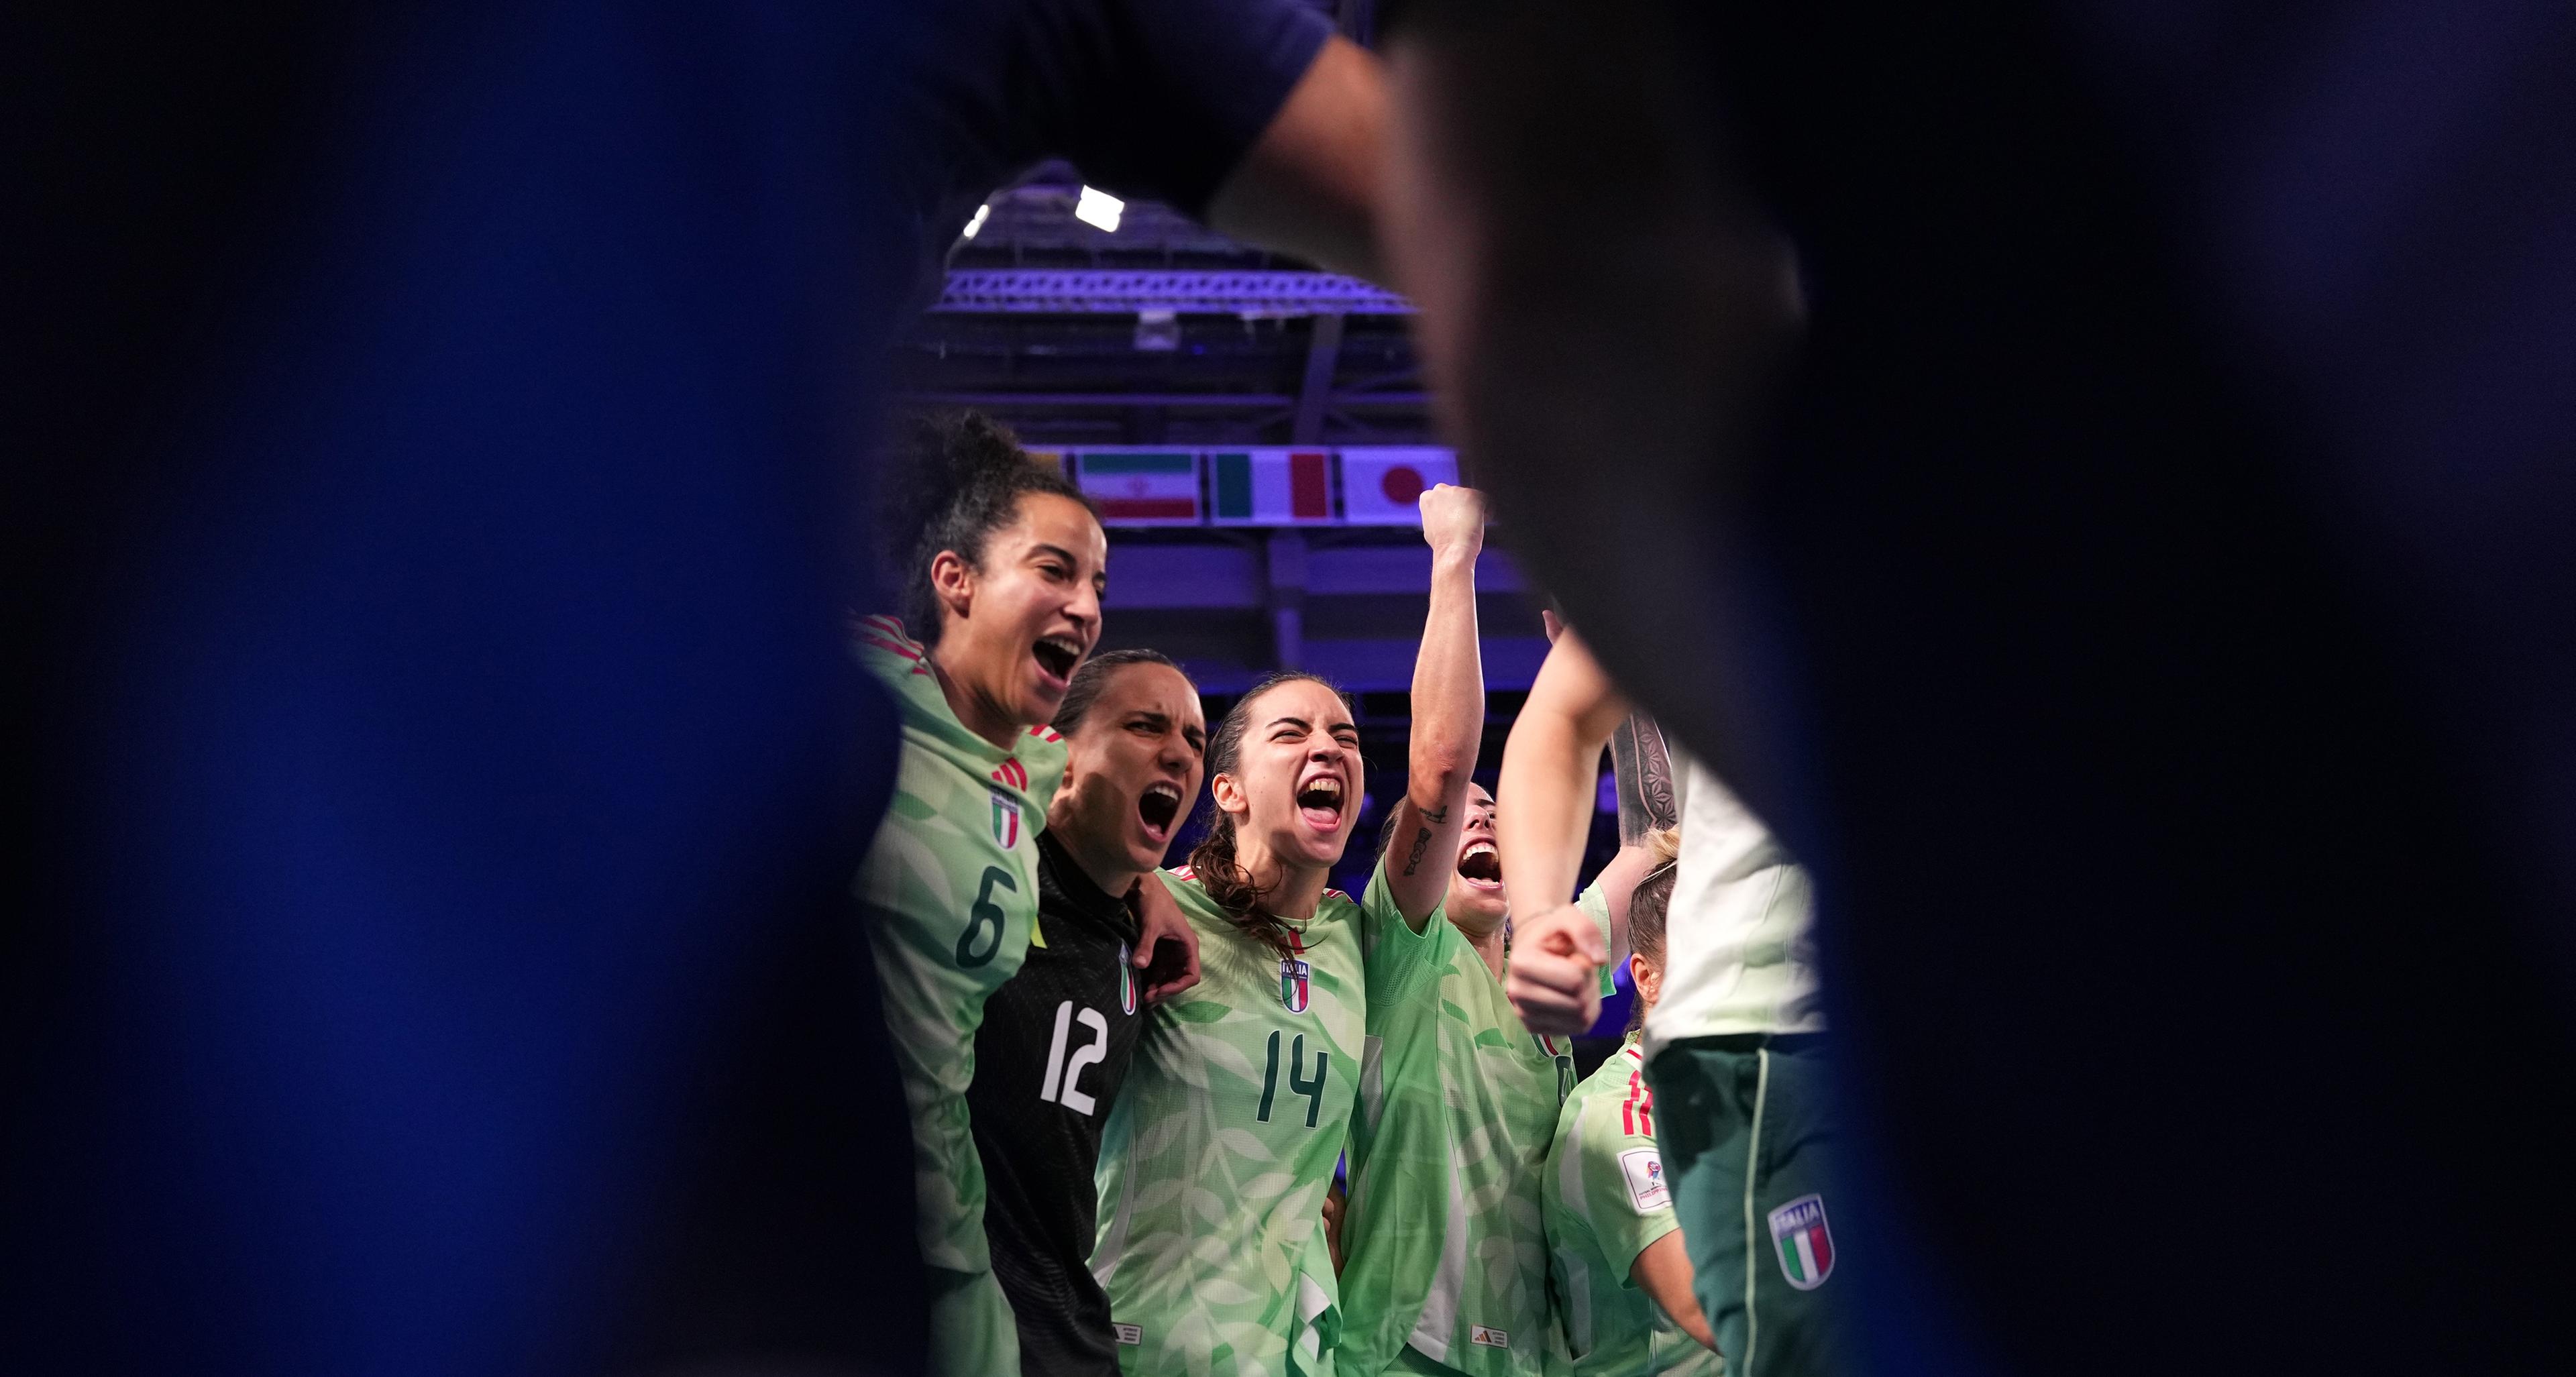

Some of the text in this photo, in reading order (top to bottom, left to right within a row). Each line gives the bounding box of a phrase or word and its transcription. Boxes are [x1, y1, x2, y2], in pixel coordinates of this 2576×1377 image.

[956, 865, 1017, 968] 6
[1040, 1000, 1108, 1117] 12
[1256, 1030, 1328, 1129] 14
